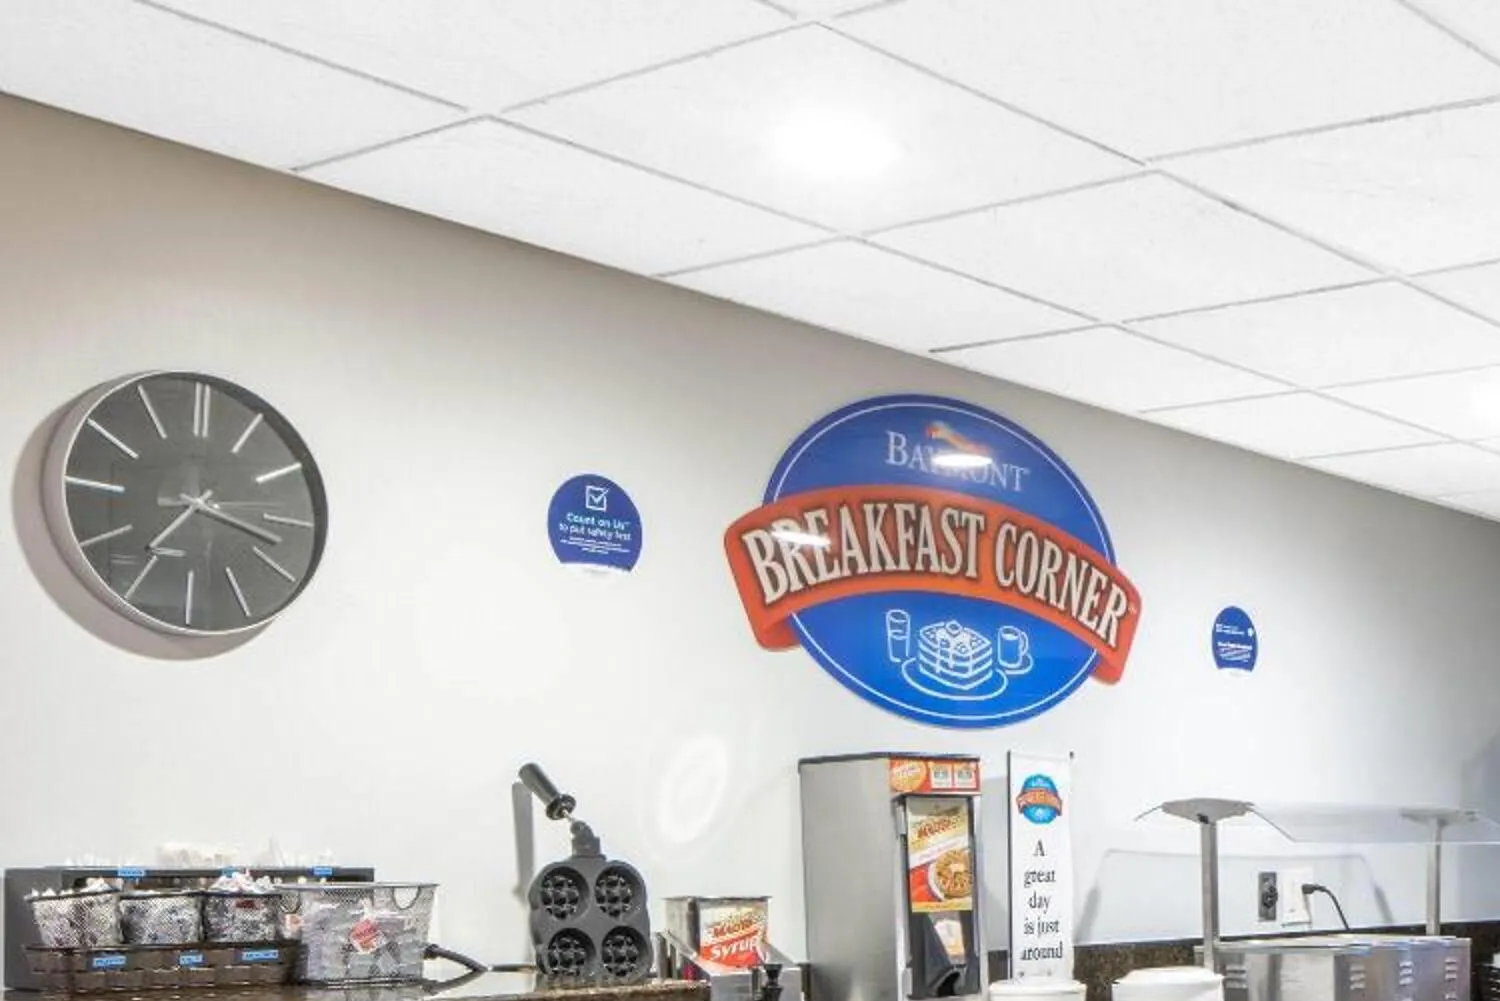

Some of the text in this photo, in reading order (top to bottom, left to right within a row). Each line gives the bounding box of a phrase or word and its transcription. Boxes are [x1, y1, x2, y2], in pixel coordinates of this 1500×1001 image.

[741, 502, 1129, 648] BREAKFAST CORNER
[1033, 839, 1046, 857] A
[1023, 869, 1056, 888] great
[1028, 891, 1051, 914] day
[1023, 916, 1060, 938] is just
[1020, 940, 1064, 961] around
